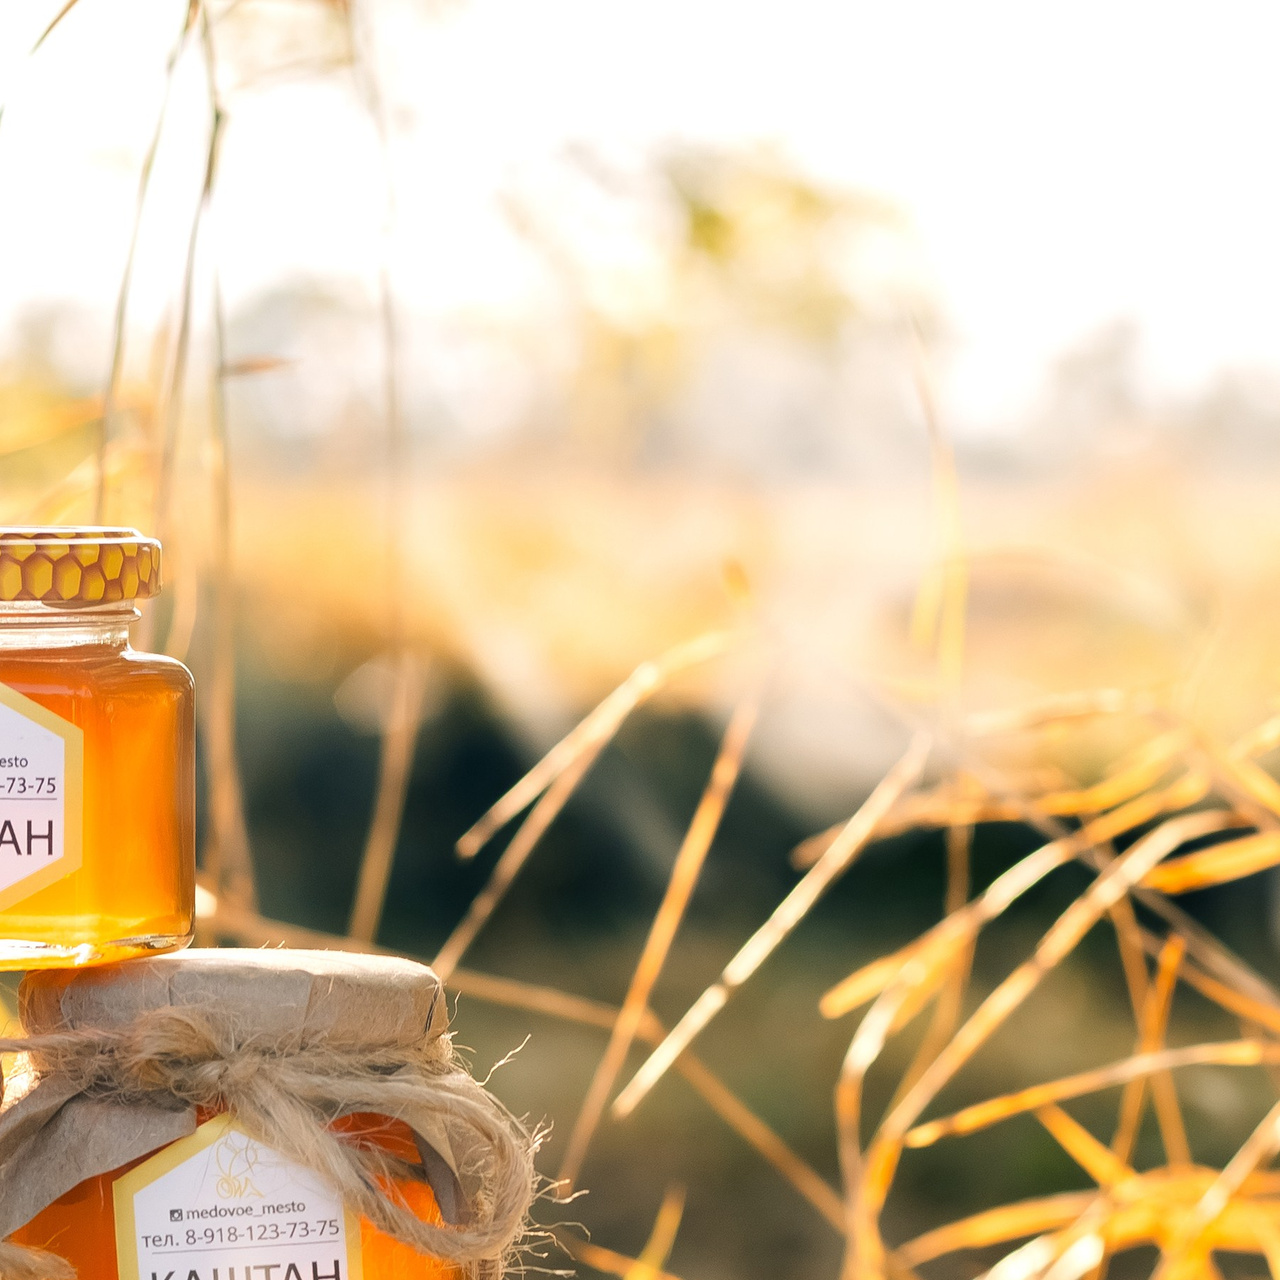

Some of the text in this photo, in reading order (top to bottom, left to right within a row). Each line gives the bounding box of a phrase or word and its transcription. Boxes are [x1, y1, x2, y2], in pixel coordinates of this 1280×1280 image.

[186, 1201, 306, 1220] medovoe_mesto
[142, 1219, 339, 1248] тел. 8-918-123-73-75
